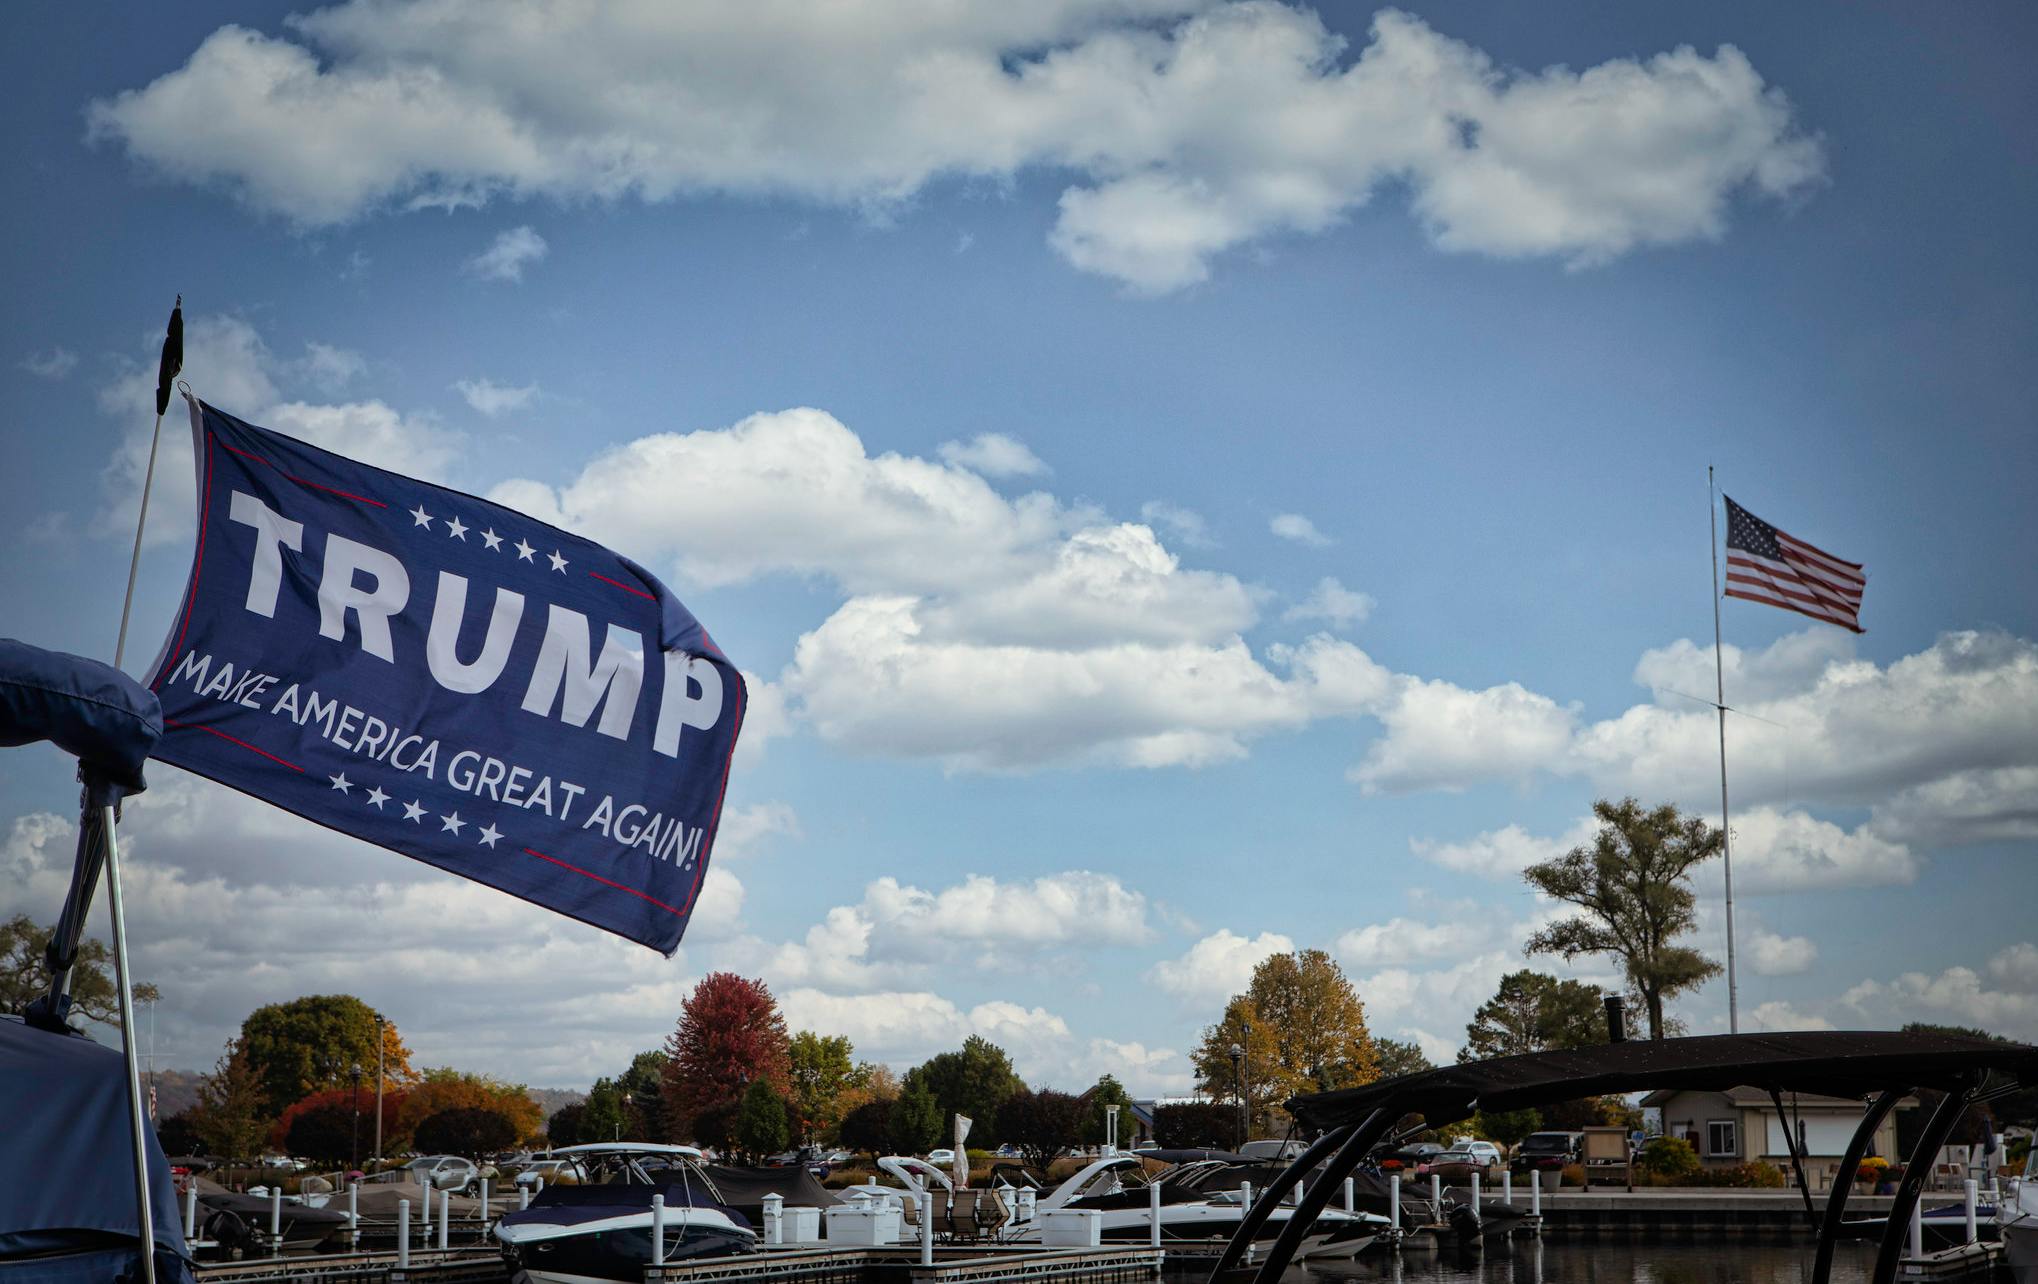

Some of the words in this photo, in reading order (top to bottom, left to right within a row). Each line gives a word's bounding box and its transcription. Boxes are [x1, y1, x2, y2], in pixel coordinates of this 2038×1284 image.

[230, 490, 724, 759] TRUMP
[169, 650, 279, 710] MAKE
[271, 684, 440, 780] AMERICA
[448, 750, 586, 822] GREAT
[583, 795, 705, 872] AGAIN!
